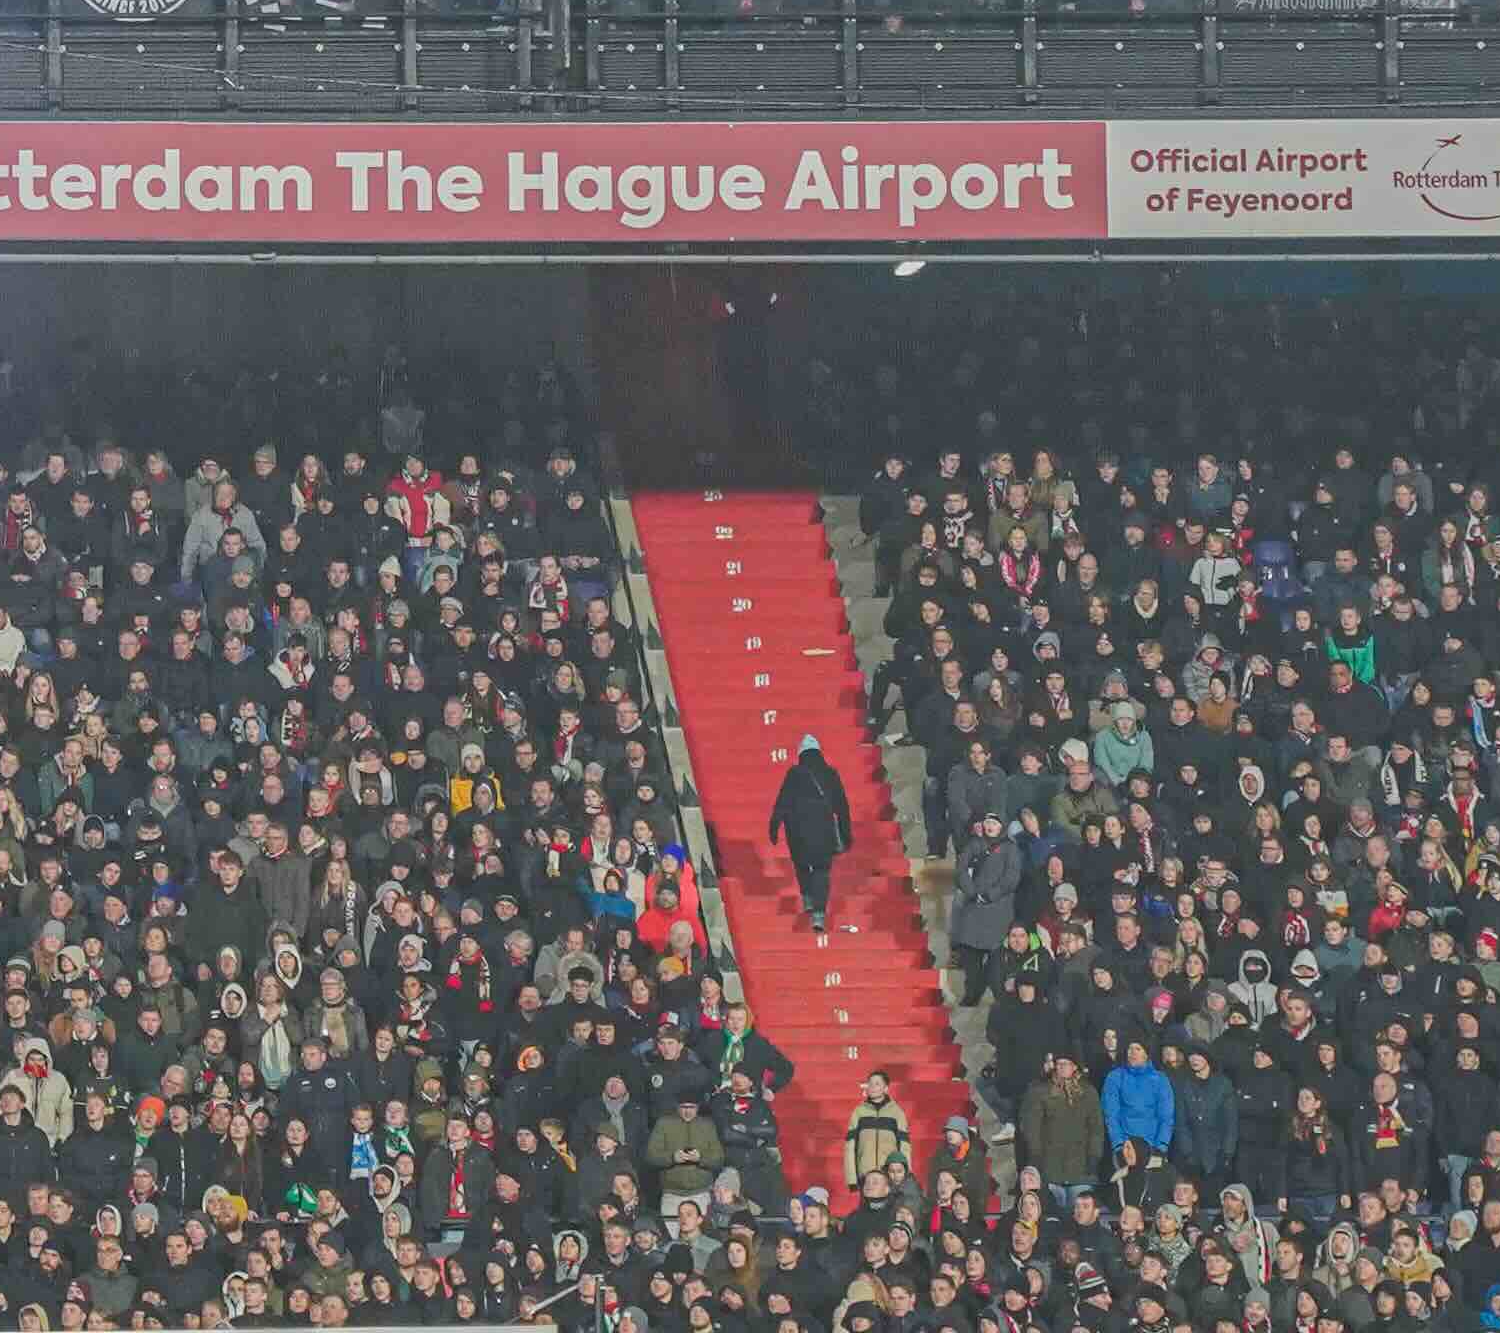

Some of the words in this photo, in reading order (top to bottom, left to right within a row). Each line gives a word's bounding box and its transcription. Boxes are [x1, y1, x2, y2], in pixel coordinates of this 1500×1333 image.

[1129, 146, 1247, 175] Official
[1254, 145, 1368, 181] Airport
[1392, 170, 1487, 190] Rotterdam
[336, 150, 480, 212] The
[508, 150, 765, 228] Hague
[785, 145, 1074, 225] Airport
[1145, 186, 1179, 212] of
[1187, 186, 1354, 219] Feyenoord
